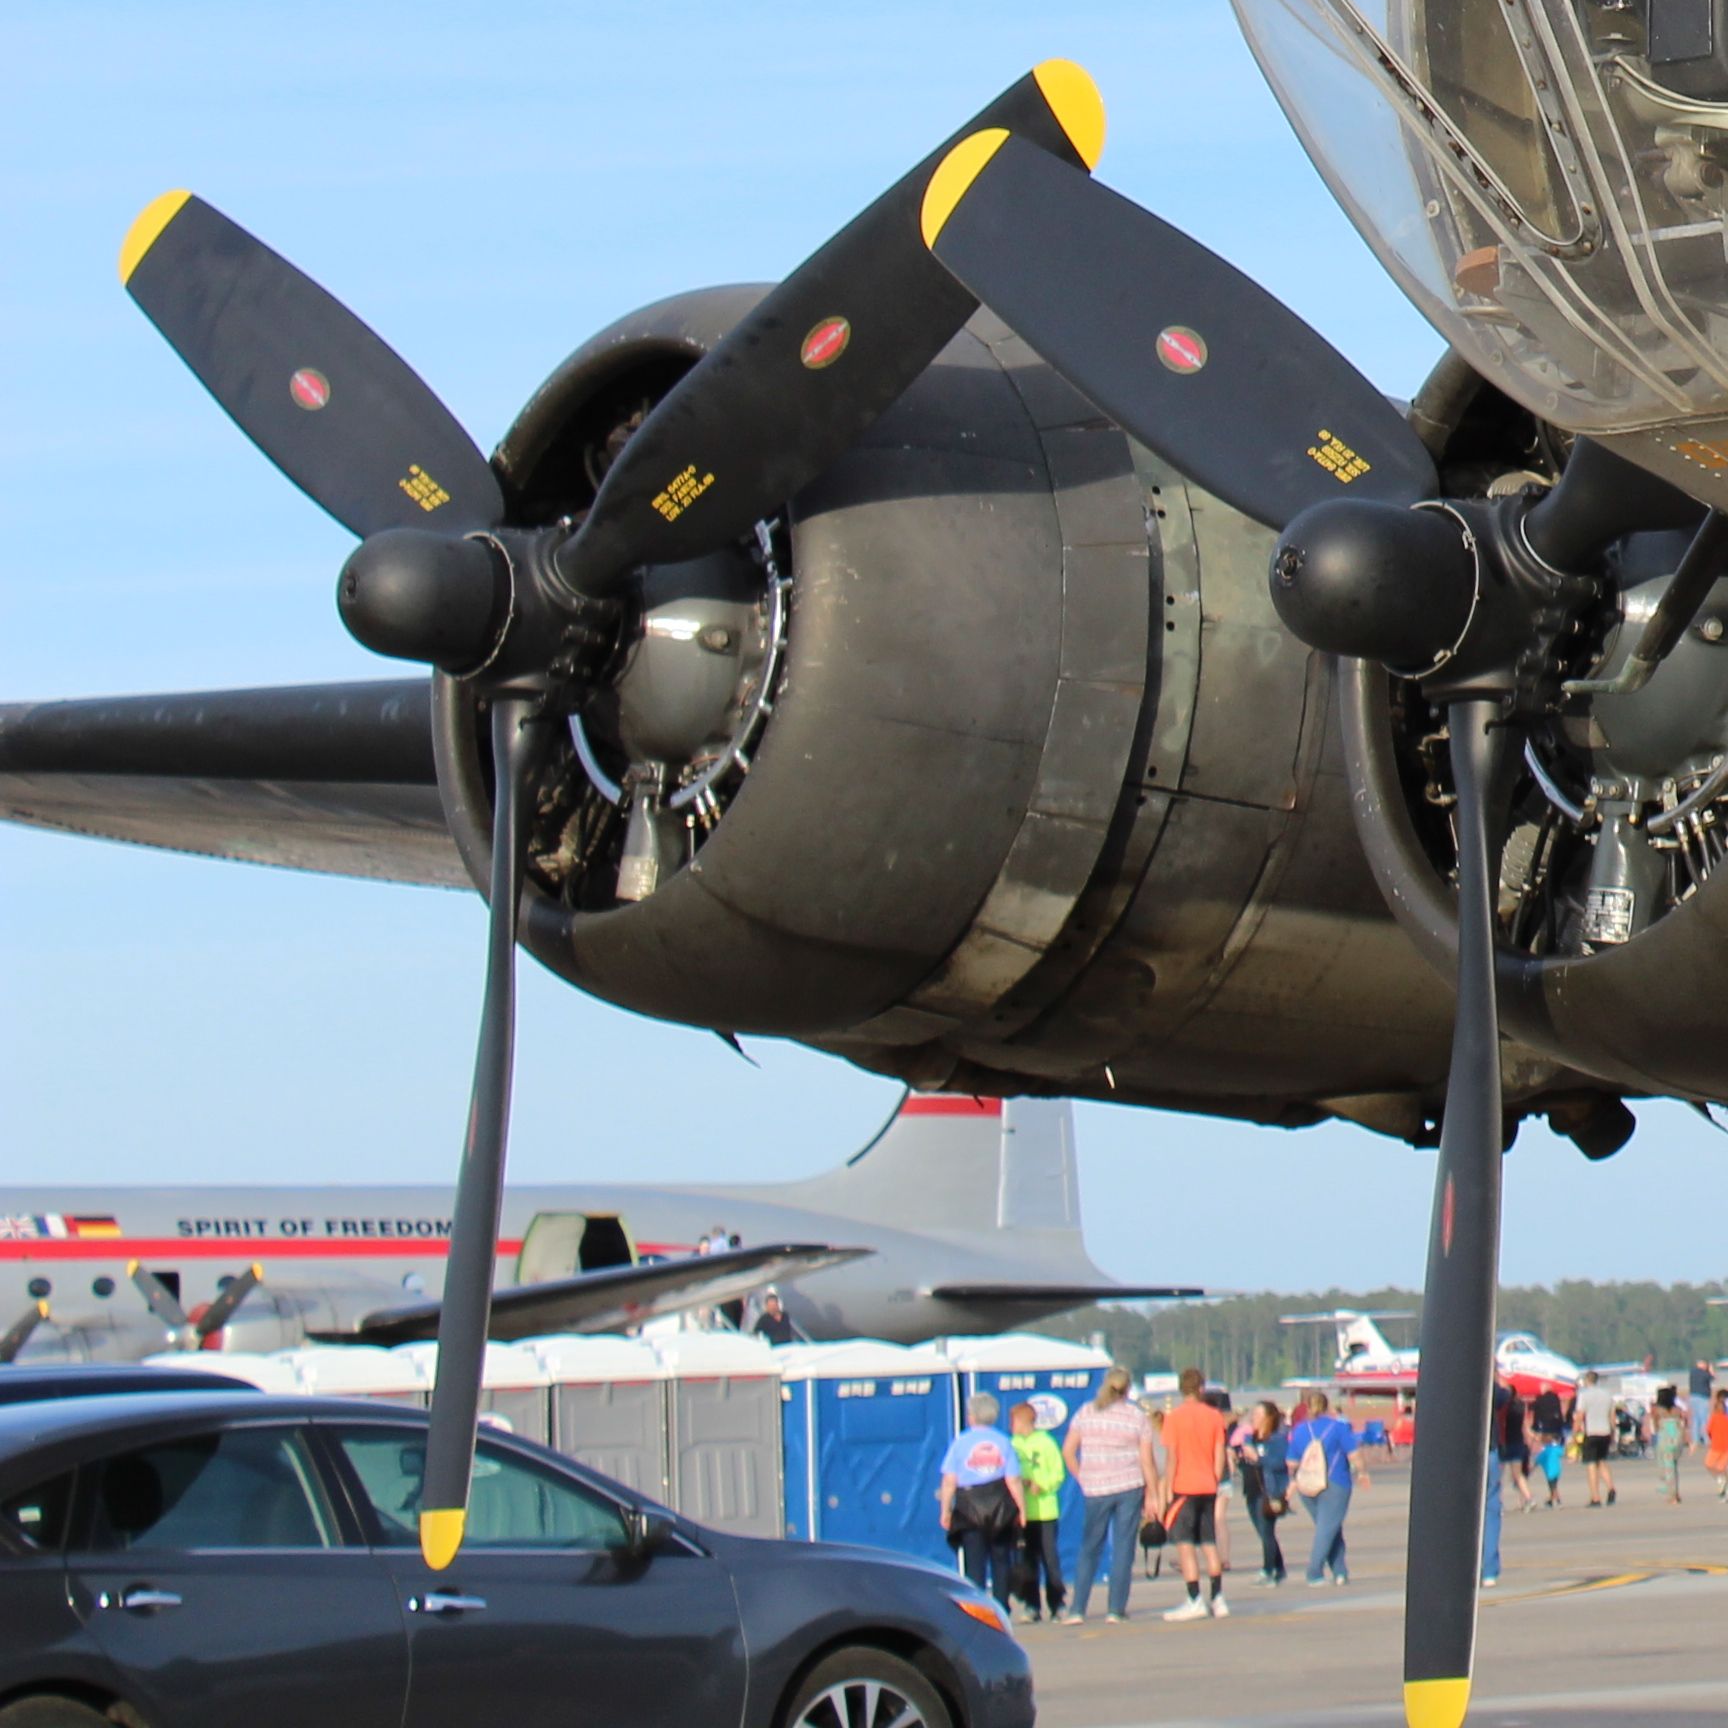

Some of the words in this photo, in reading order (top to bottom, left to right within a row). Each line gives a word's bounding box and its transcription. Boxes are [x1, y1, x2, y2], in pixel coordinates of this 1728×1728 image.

[177, 1219, 268, 1238] SPIRIT
[279, 1219, 315, 1238] OF
[325, 1219, 454, 1238] FREEDOM
